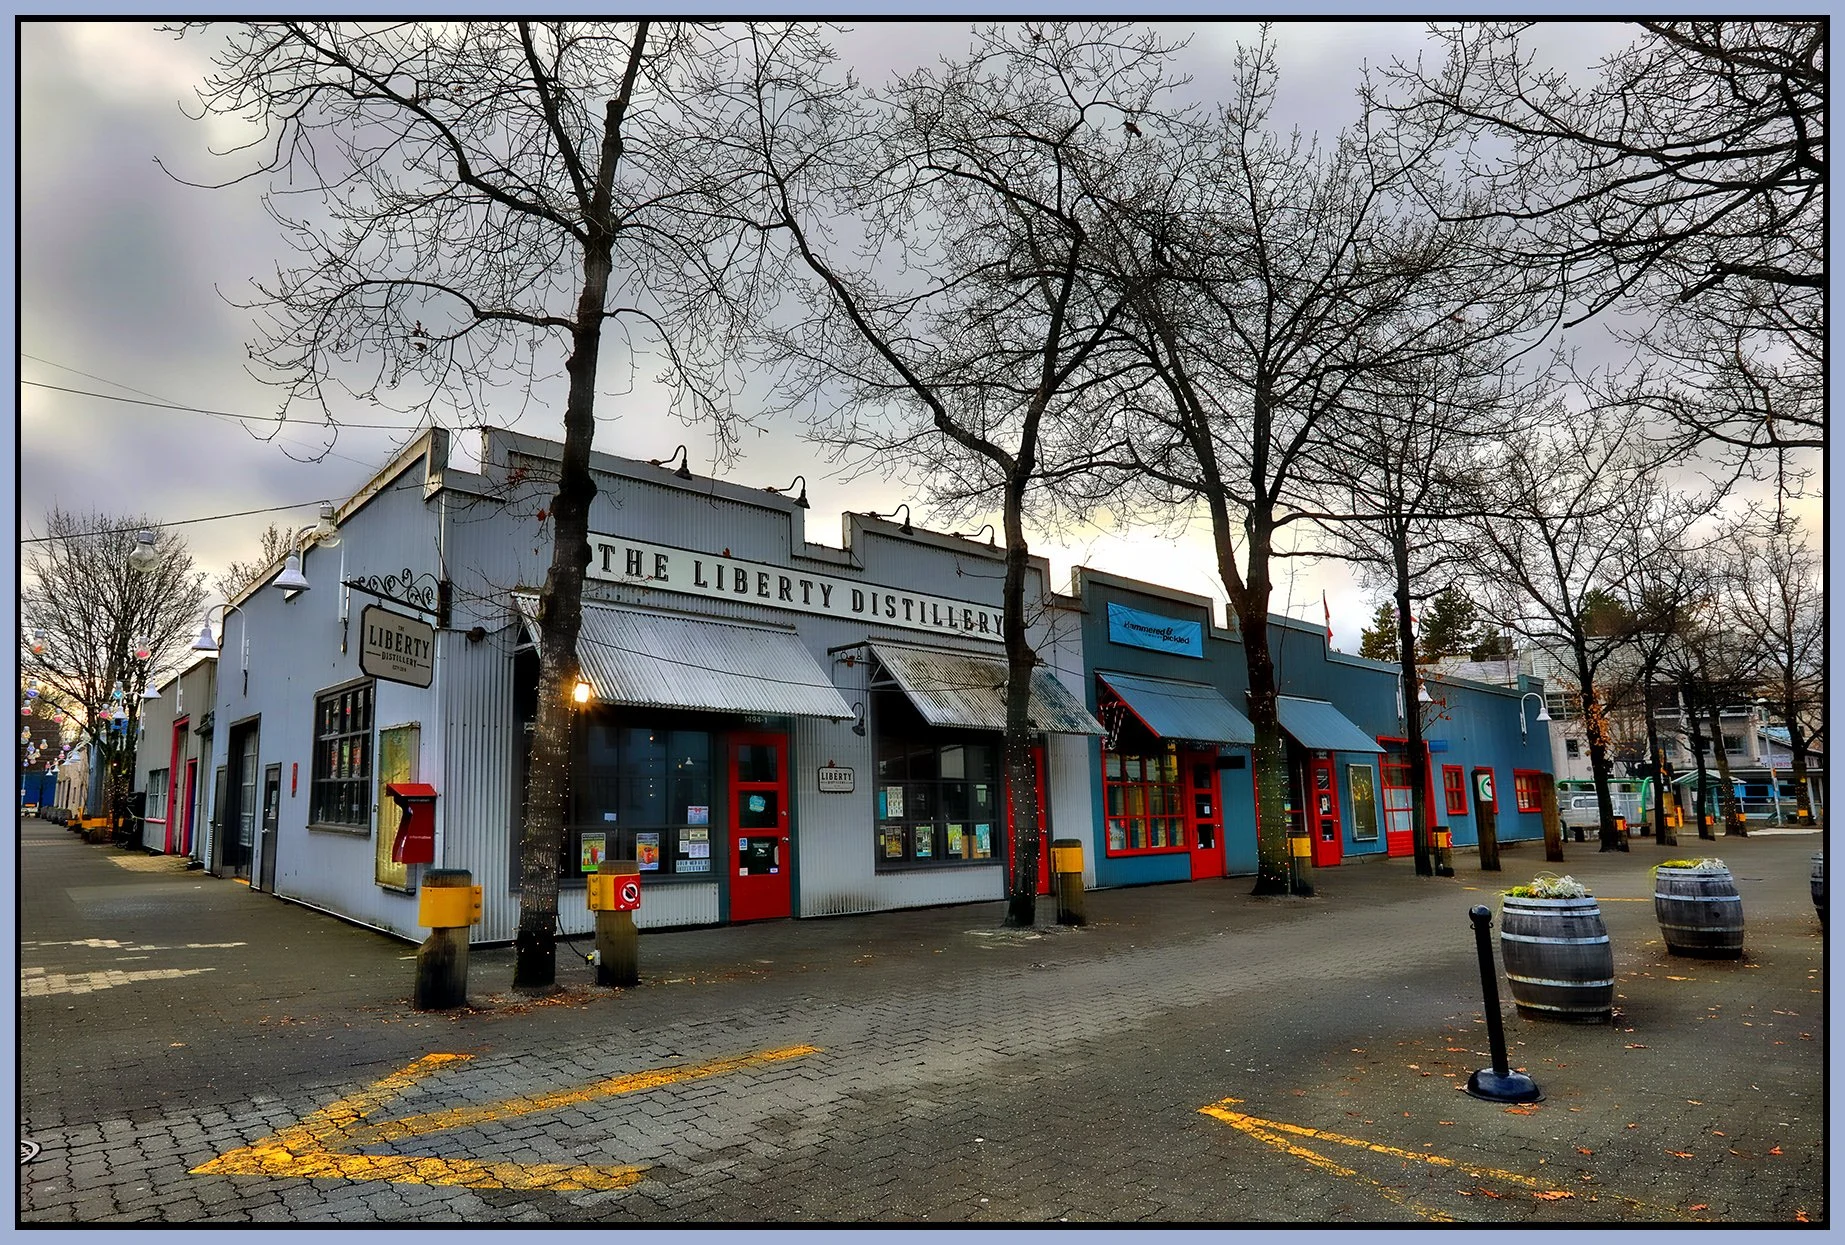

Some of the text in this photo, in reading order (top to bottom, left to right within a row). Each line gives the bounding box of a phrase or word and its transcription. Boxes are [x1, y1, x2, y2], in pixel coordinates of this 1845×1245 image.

[598, 543, 1005, 636] THE LIBERTY DISTILLERY
[1124, 621, 1165, 635] Hammered
[369, 625, 430, 659] LIBERTY
[1162, 635, 1189, 644] pickled
[381, 651, 417, 668] DISTILLERY
[821, 772, 852, 781] LIBERTY
